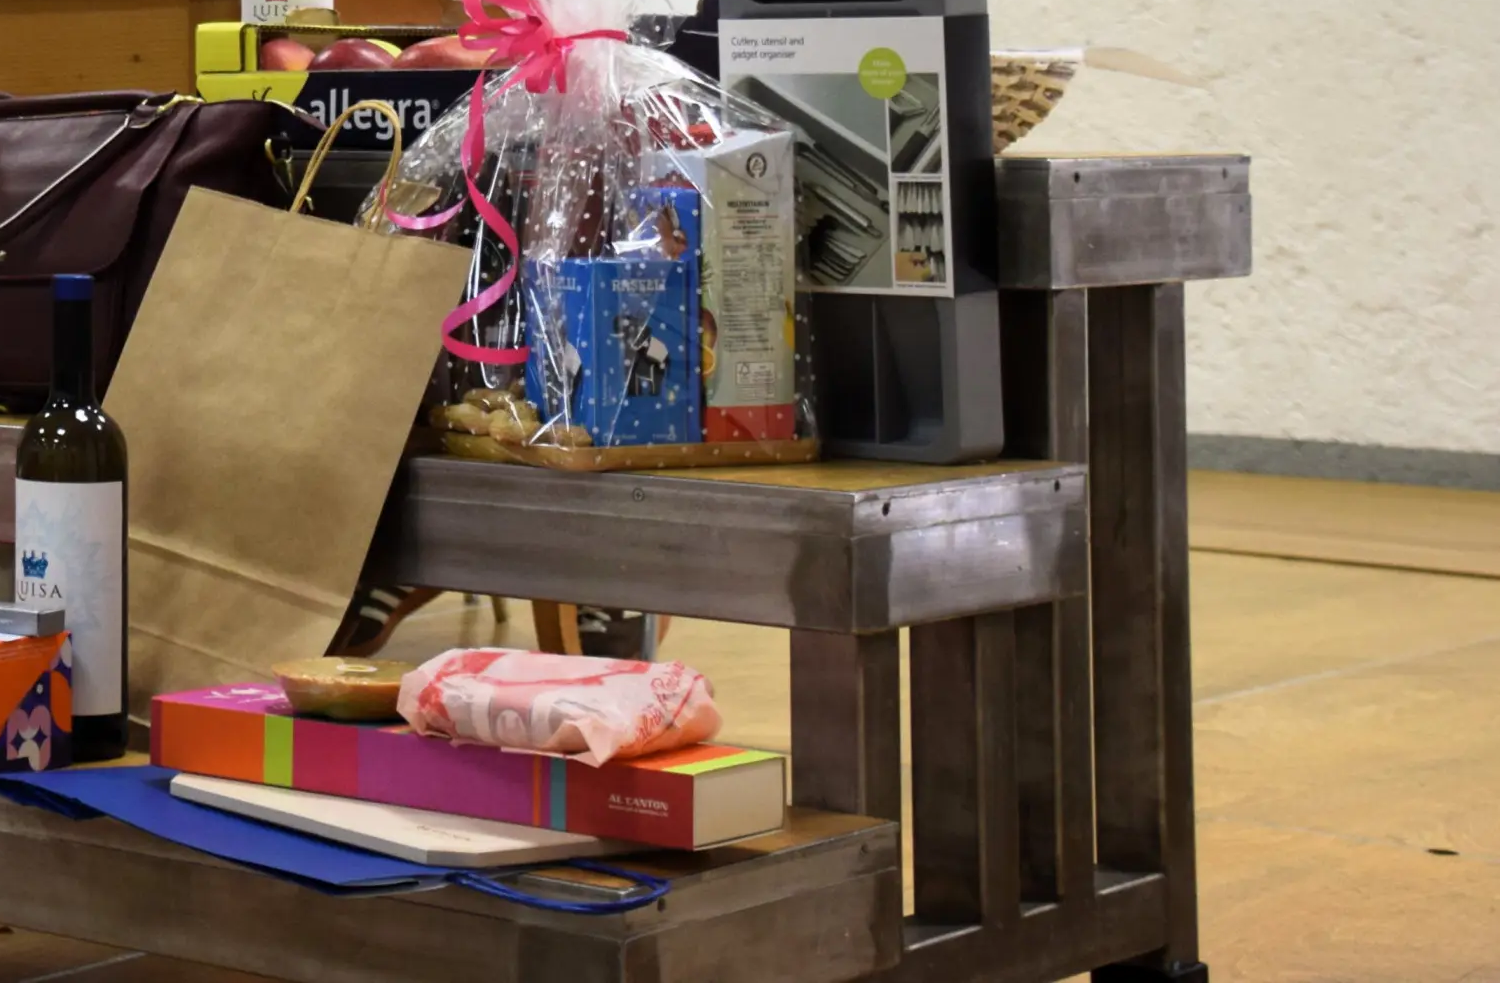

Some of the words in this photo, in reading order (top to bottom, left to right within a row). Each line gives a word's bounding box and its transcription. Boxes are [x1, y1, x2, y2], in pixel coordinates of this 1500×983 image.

[252, 3, 300, 22] LUIS
[731, 37, 759, 47] Cutlery,
[761, 37, 787, 46] utensil
[788, 37, 805, 46] and
[731, 50, 758, 60] gadget
[759, 51, 796, 61] organiser
[310, 88, 432, 141] allegra
[609, 793, 623, 804] AL
[625, 797, 669, 811] CANTON
